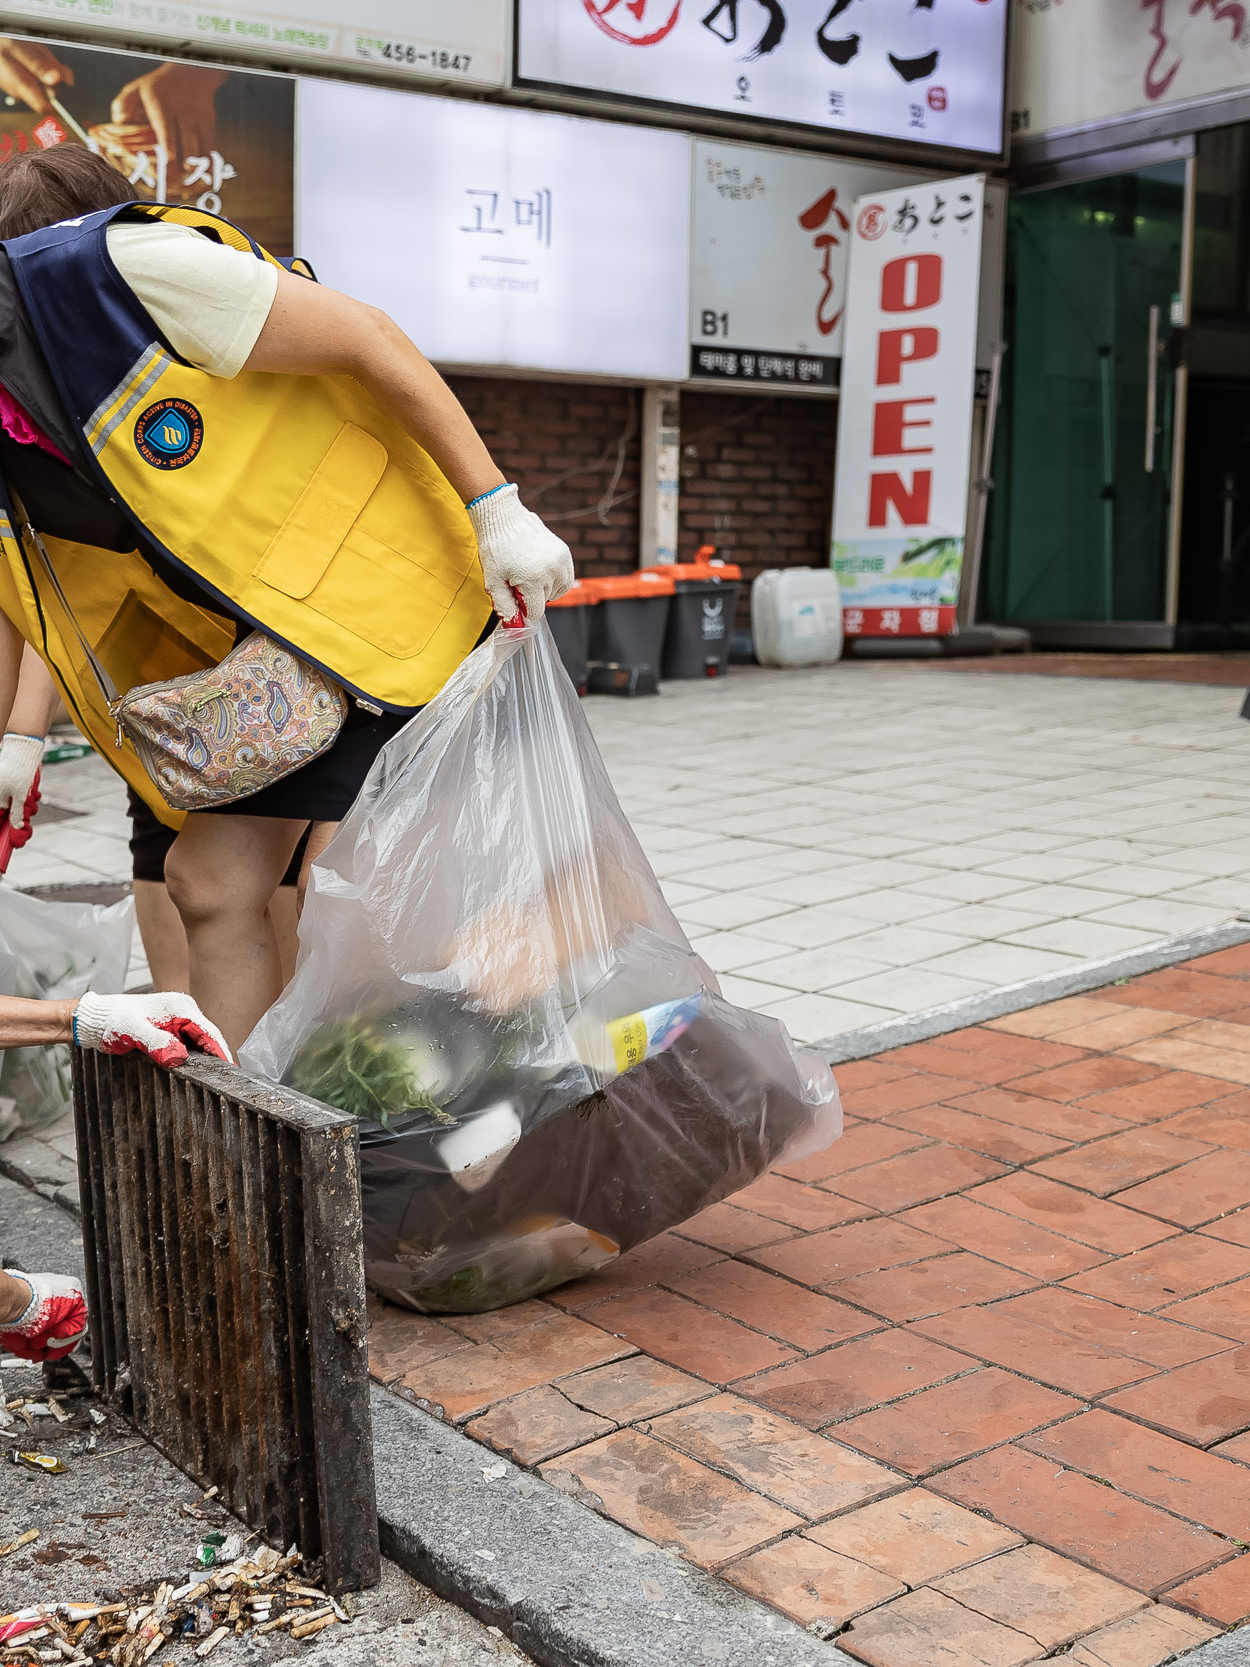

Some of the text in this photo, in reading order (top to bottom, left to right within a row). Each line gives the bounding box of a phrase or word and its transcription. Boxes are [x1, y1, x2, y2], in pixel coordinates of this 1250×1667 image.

[382, 41, 473, 72] 456-1847
[459, 187, 552, 249] 고메
[701, 310, 729, 338] B1
[741, 354, 756, 377] 및
[867, 254, 943, 528] OPEN
[143, 403, 164, 421] ACTIVE
[174, 401, 199, 421] DISASTER
[136, 421, 146, 444] CORPS
[140, 445, 162, 465] CITIZEN
